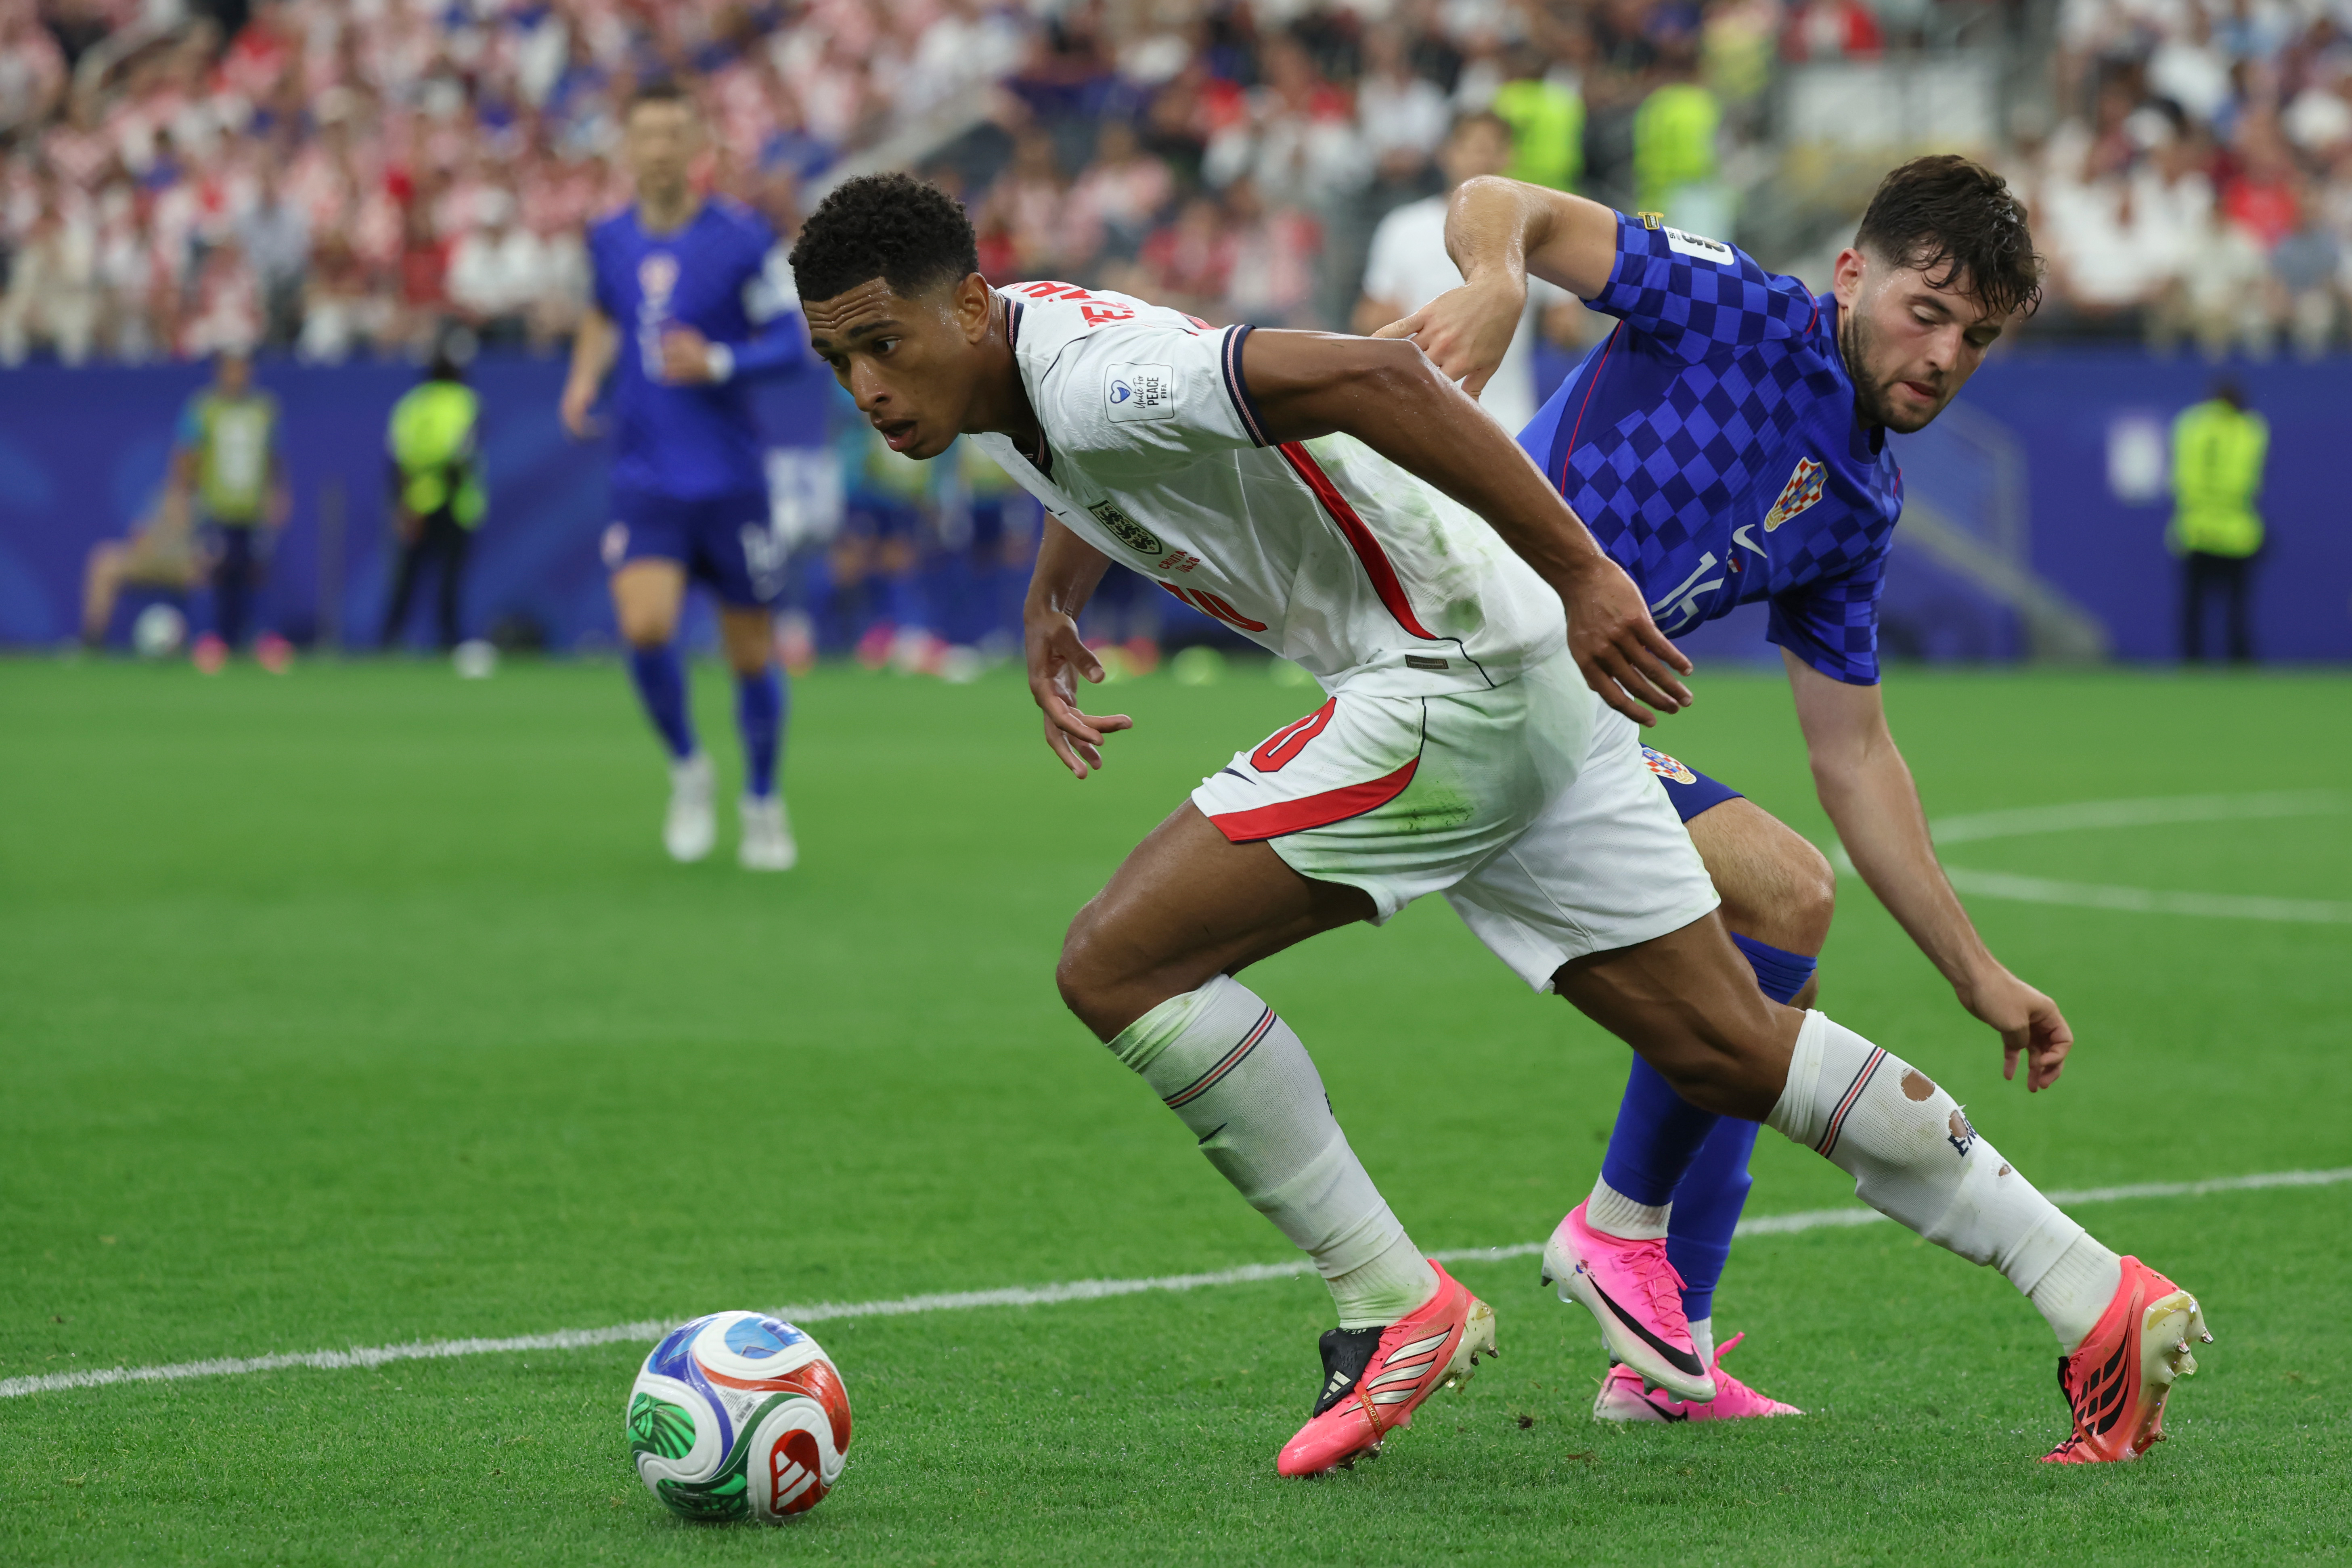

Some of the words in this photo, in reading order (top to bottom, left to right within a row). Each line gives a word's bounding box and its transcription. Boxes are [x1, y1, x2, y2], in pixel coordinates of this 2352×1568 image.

[1133, 375, 1145, 387] For
[1146, 377, 1159, 406] PEACE
[1132, 387, 1146, 408] Unite
[1361, 1393, 1383, 1431] PREDATOR
